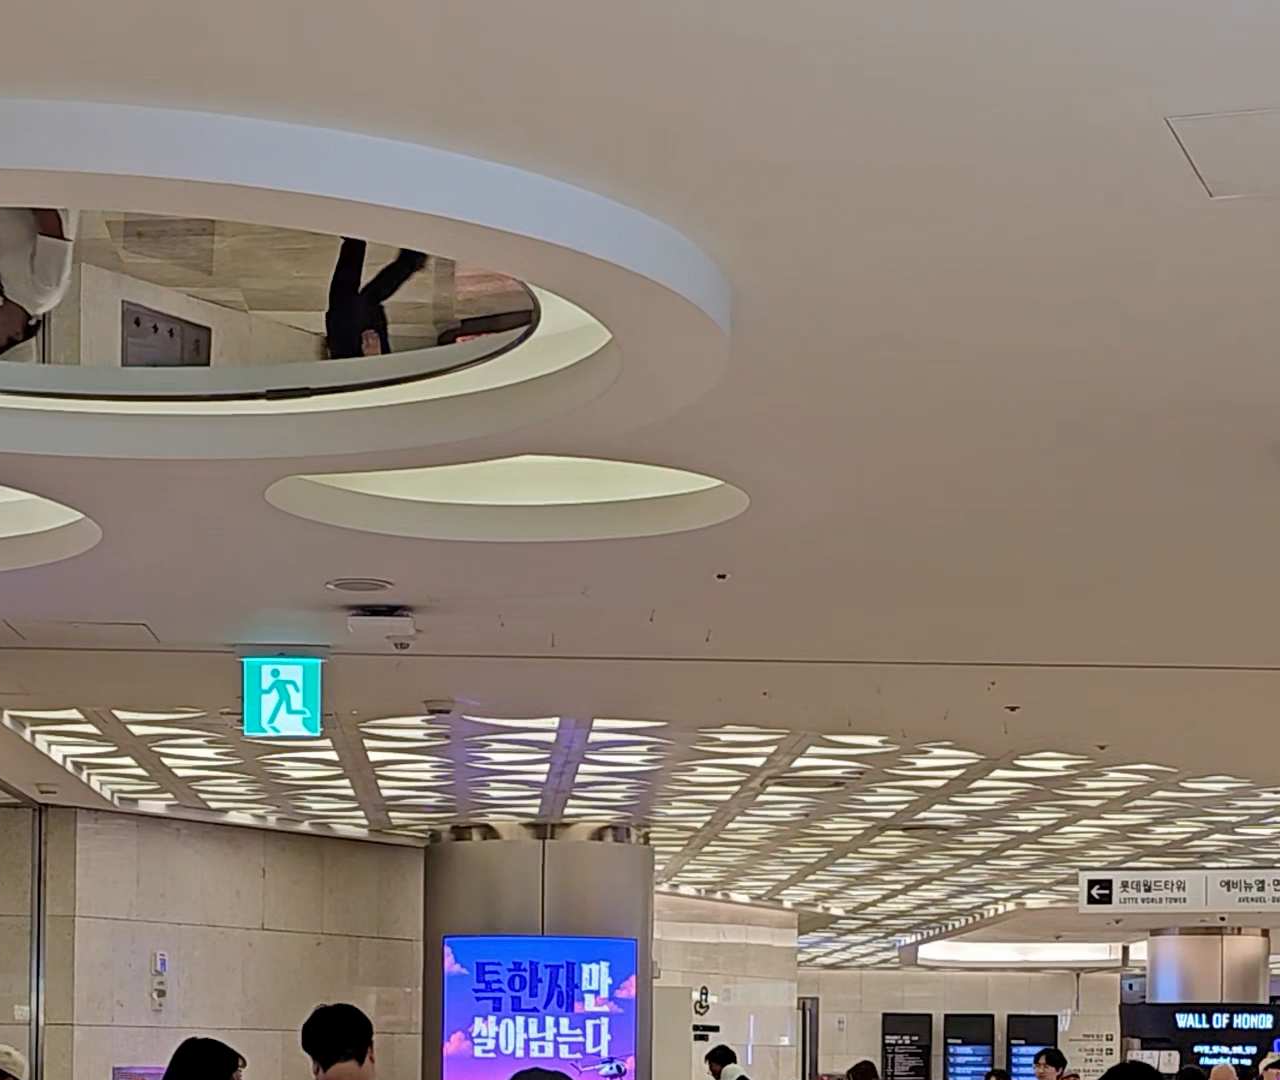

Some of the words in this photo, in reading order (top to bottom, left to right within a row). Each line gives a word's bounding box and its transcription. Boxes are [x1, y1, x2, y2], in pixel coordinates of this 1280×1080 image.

[1119, 879, 1186, 893] 롯데월드타워
[1175, 1013, 1209, 1029] WALL
[1212, 1013, 1230, 1029] OF
[1233, 1013, 1274, 1029] HONOR
[472, 1015, 611, 1058] 살아남는다
